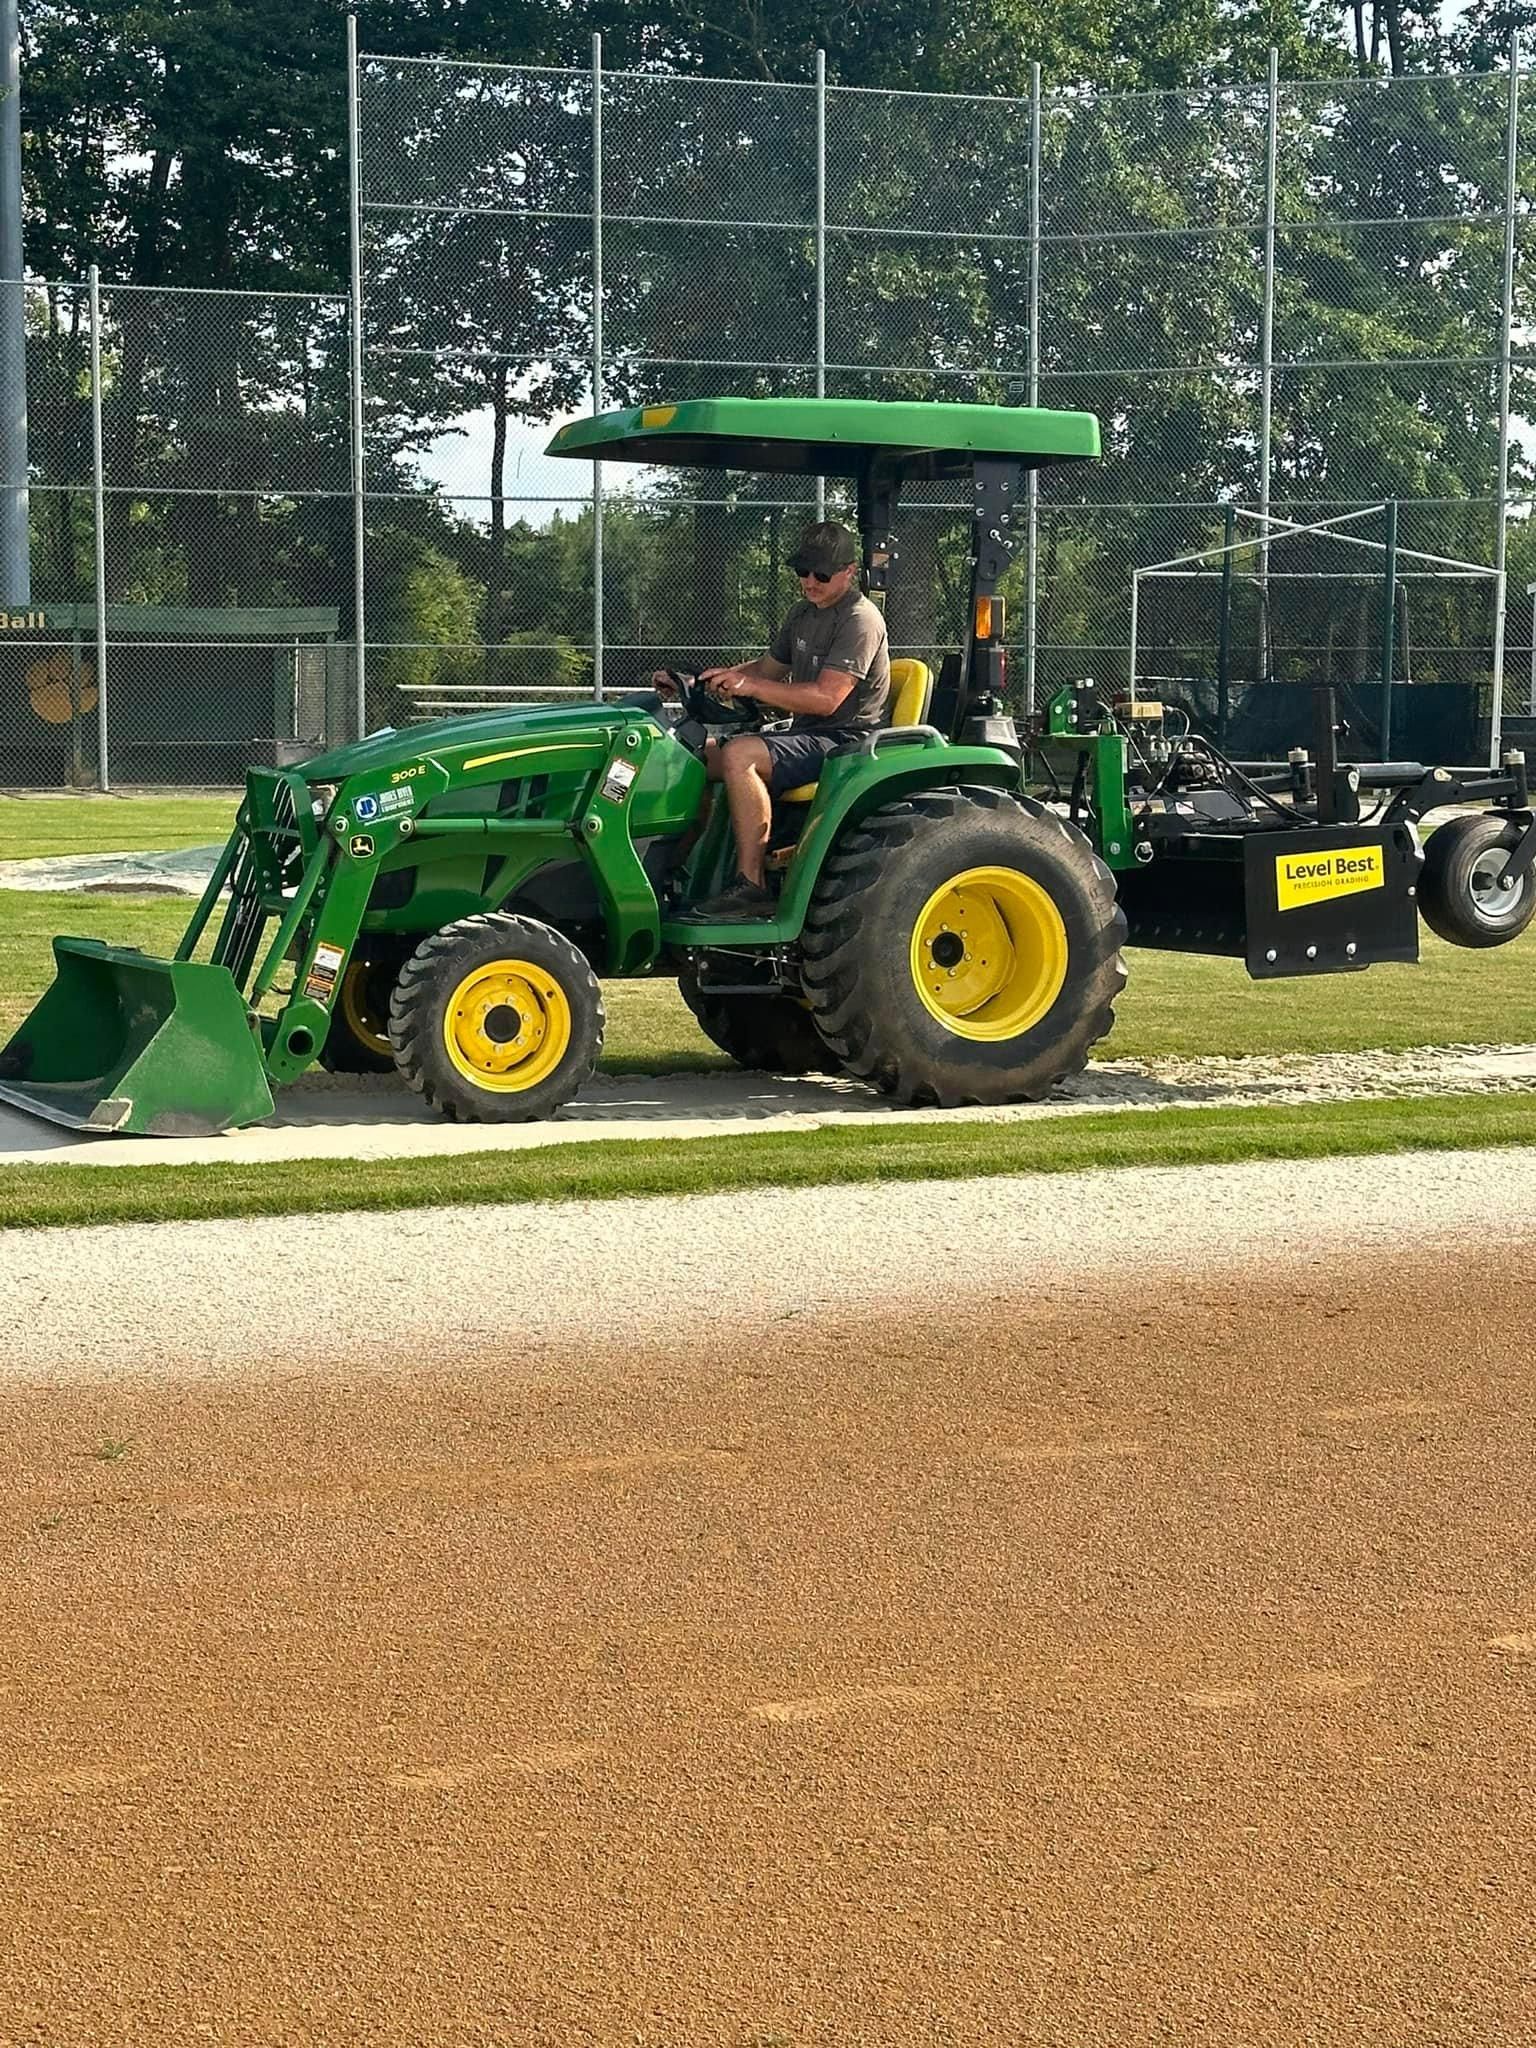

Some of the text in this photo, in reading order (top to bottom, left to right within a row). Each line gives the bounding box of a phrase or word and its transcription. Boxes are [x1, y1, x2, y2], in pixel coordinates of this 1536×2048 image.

[391, 768, 417, 784] 300
[1286, 856, 1375, 880] Level Best
[1293, 875, 1369, 891] PRECISION GRADING
